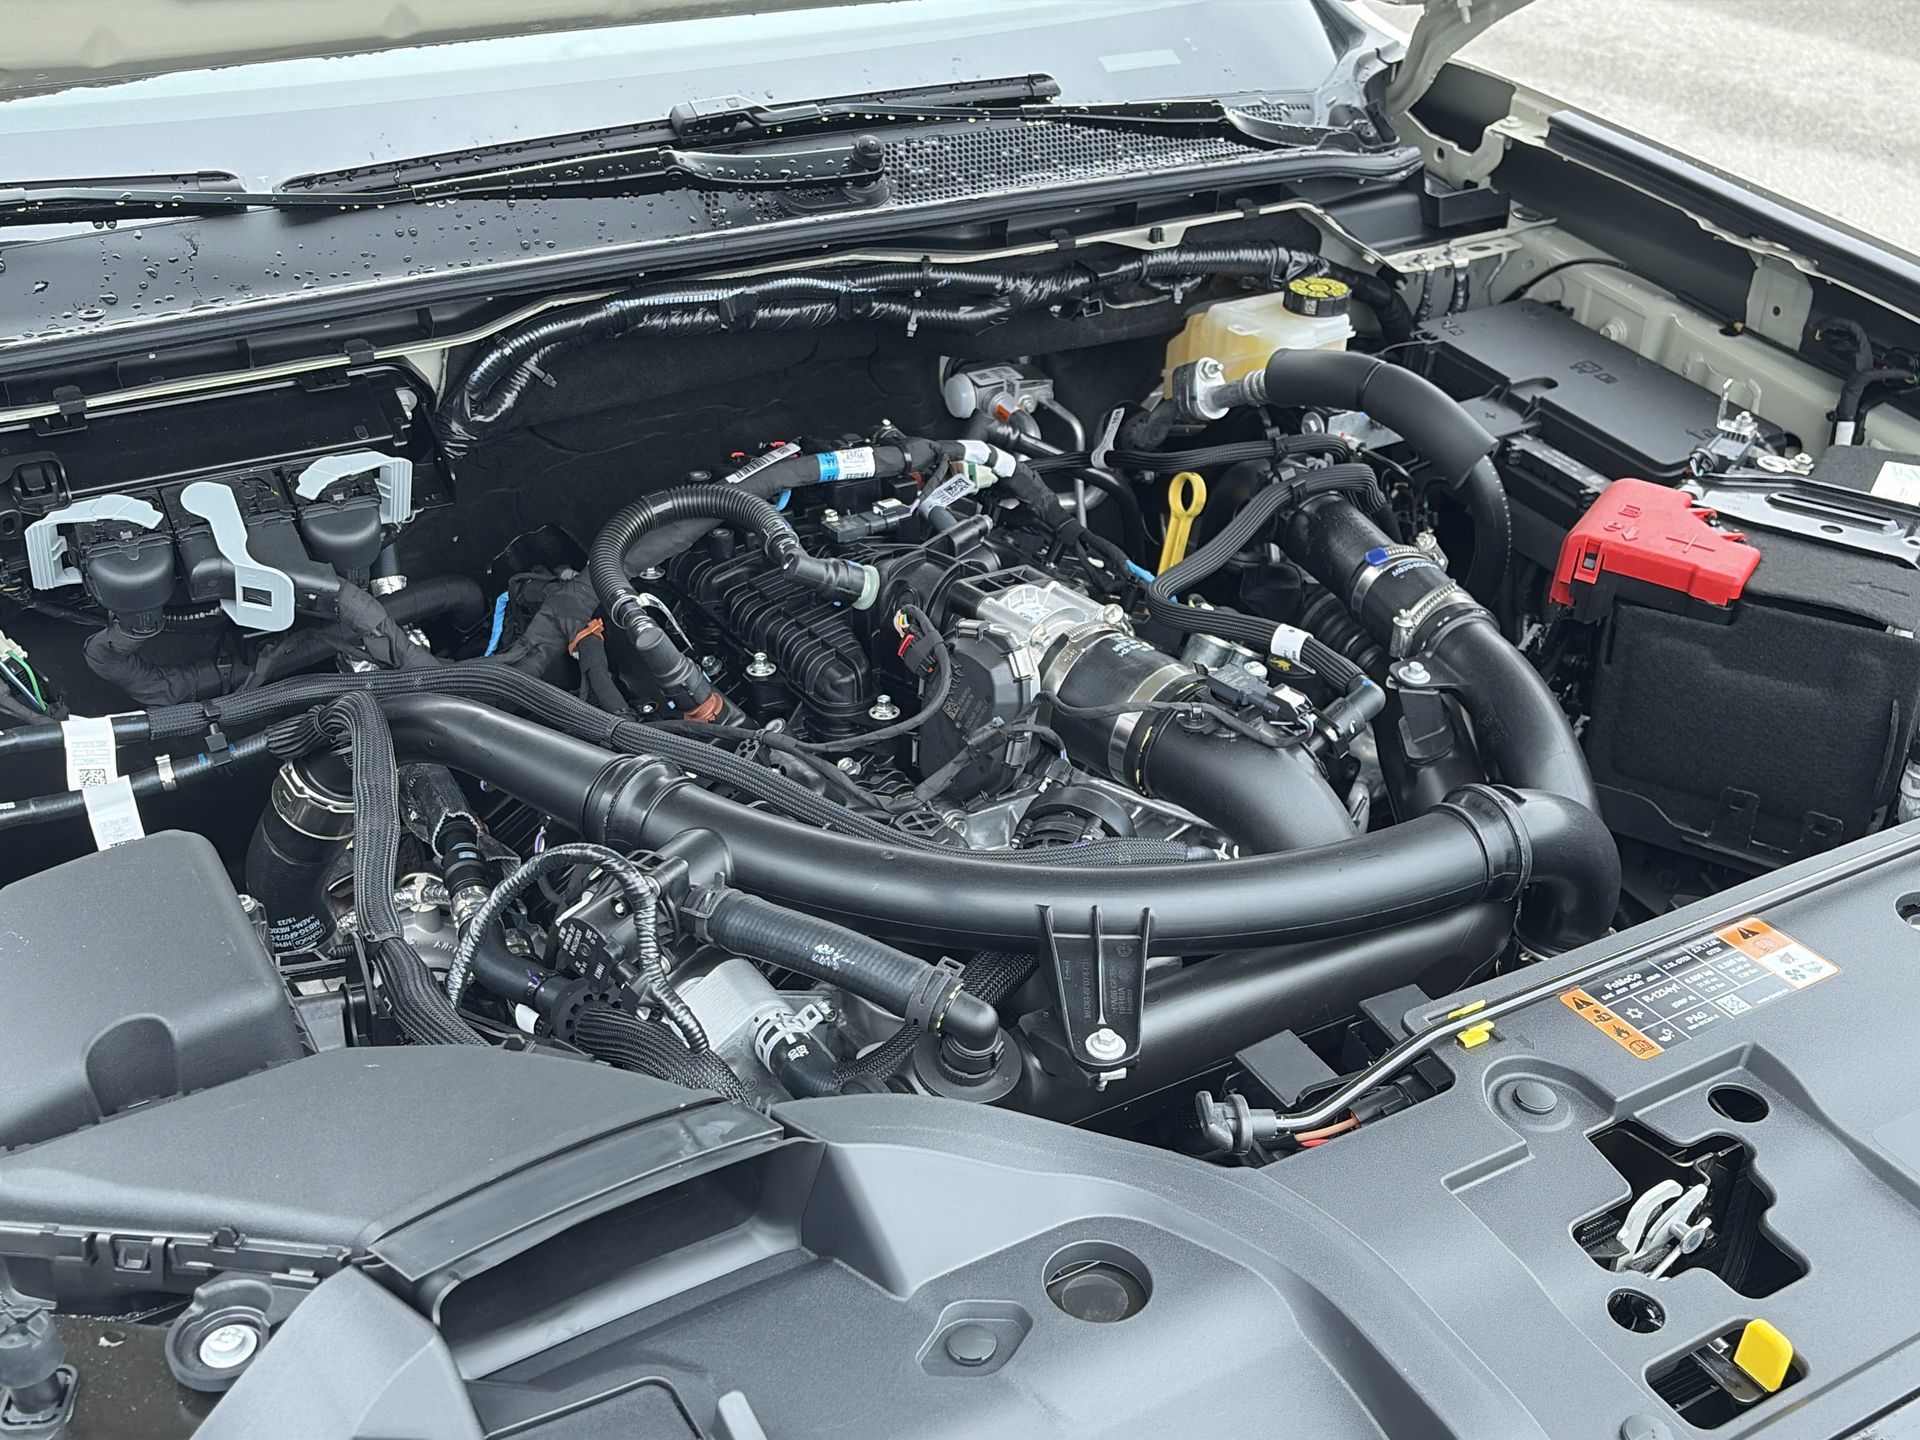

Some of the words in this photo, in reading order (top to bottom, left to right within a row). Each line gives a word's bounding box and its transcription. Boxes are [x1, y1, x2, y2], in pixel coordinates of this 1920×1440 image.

[294, 927, 323, 945] FoMoCo
[1604, 972, 1641, 990] FoMoCo
[1641, 982, 1681, 1002] R-1234yf
[1686, 1011, 1707, 1024] PAG
